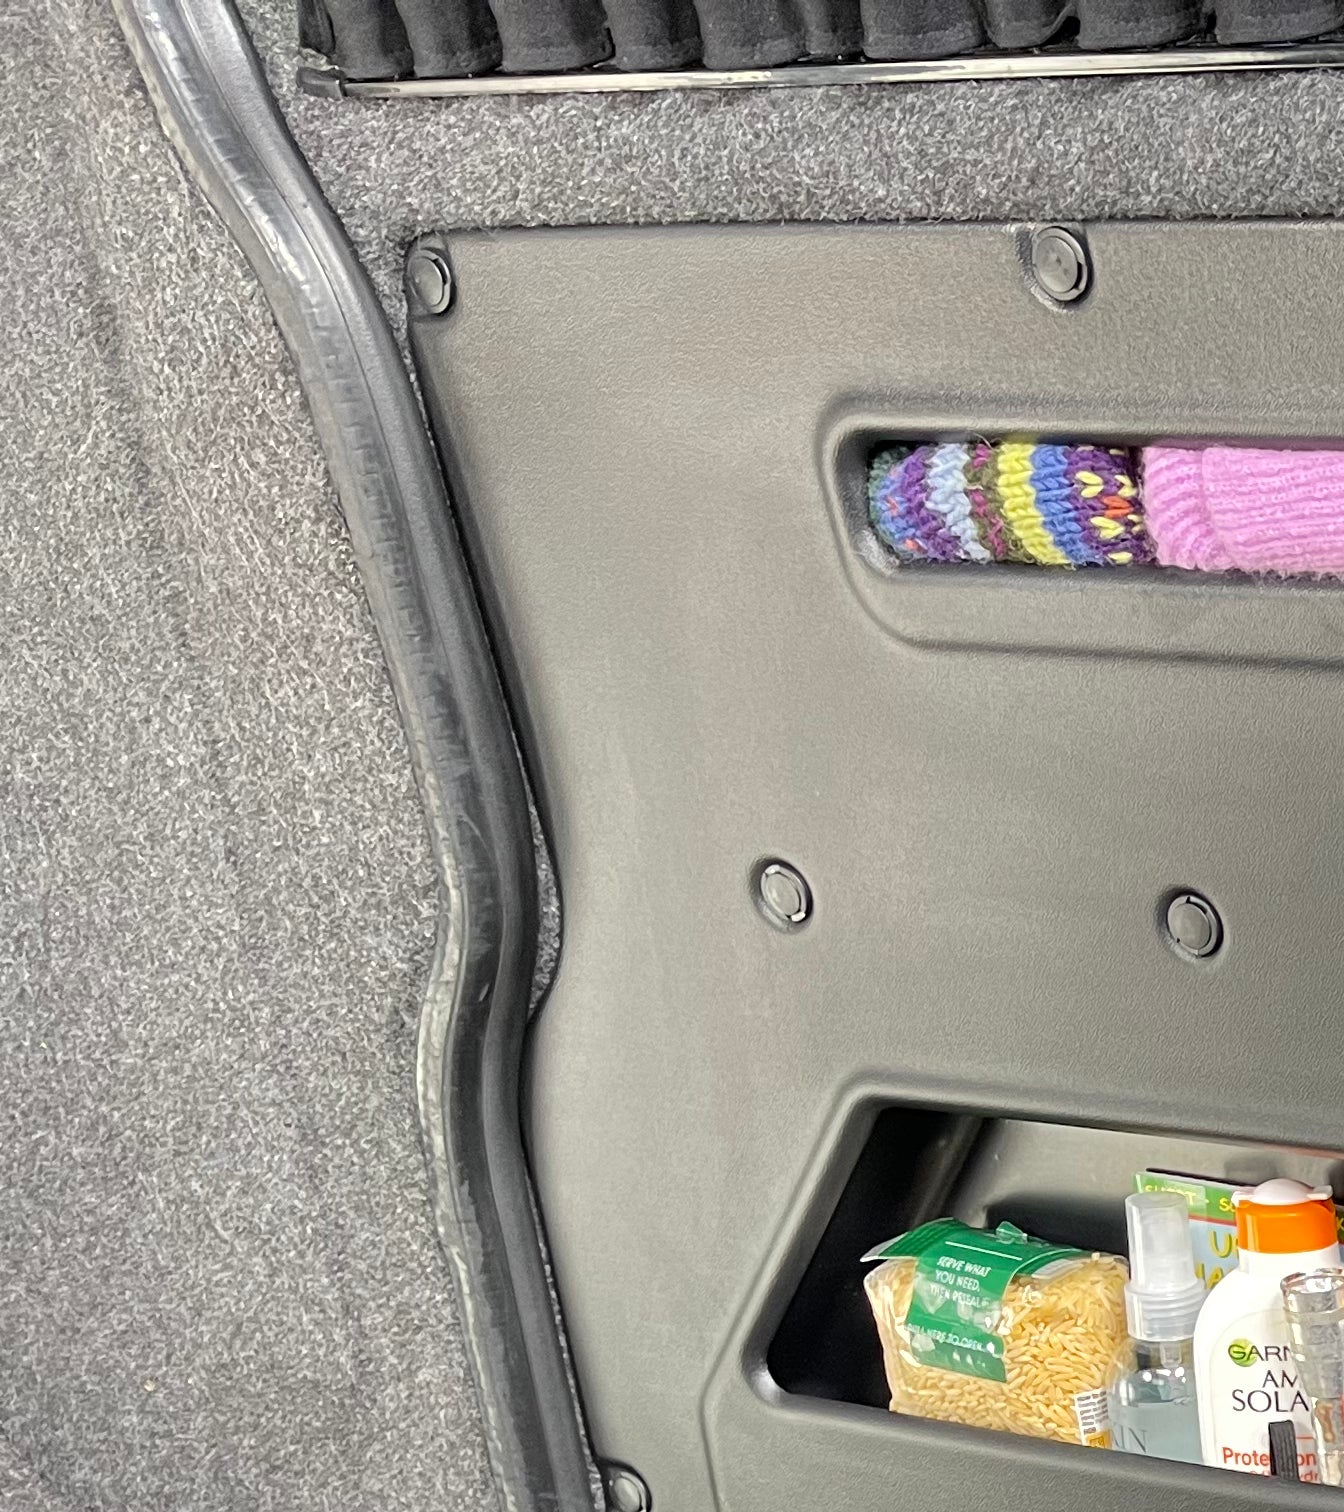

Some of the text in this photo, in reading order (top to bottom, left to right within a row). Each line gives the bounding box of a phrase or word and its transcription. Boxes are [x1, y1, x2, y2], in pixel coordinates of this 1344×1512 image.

[935, 1269, 956, 1285] YOU
[965, 1262, 992, 1277] WHAT
[1232, 1389, 1310, 1412] SOLA
[1222, 1447, 1317, 1466] Proteon
